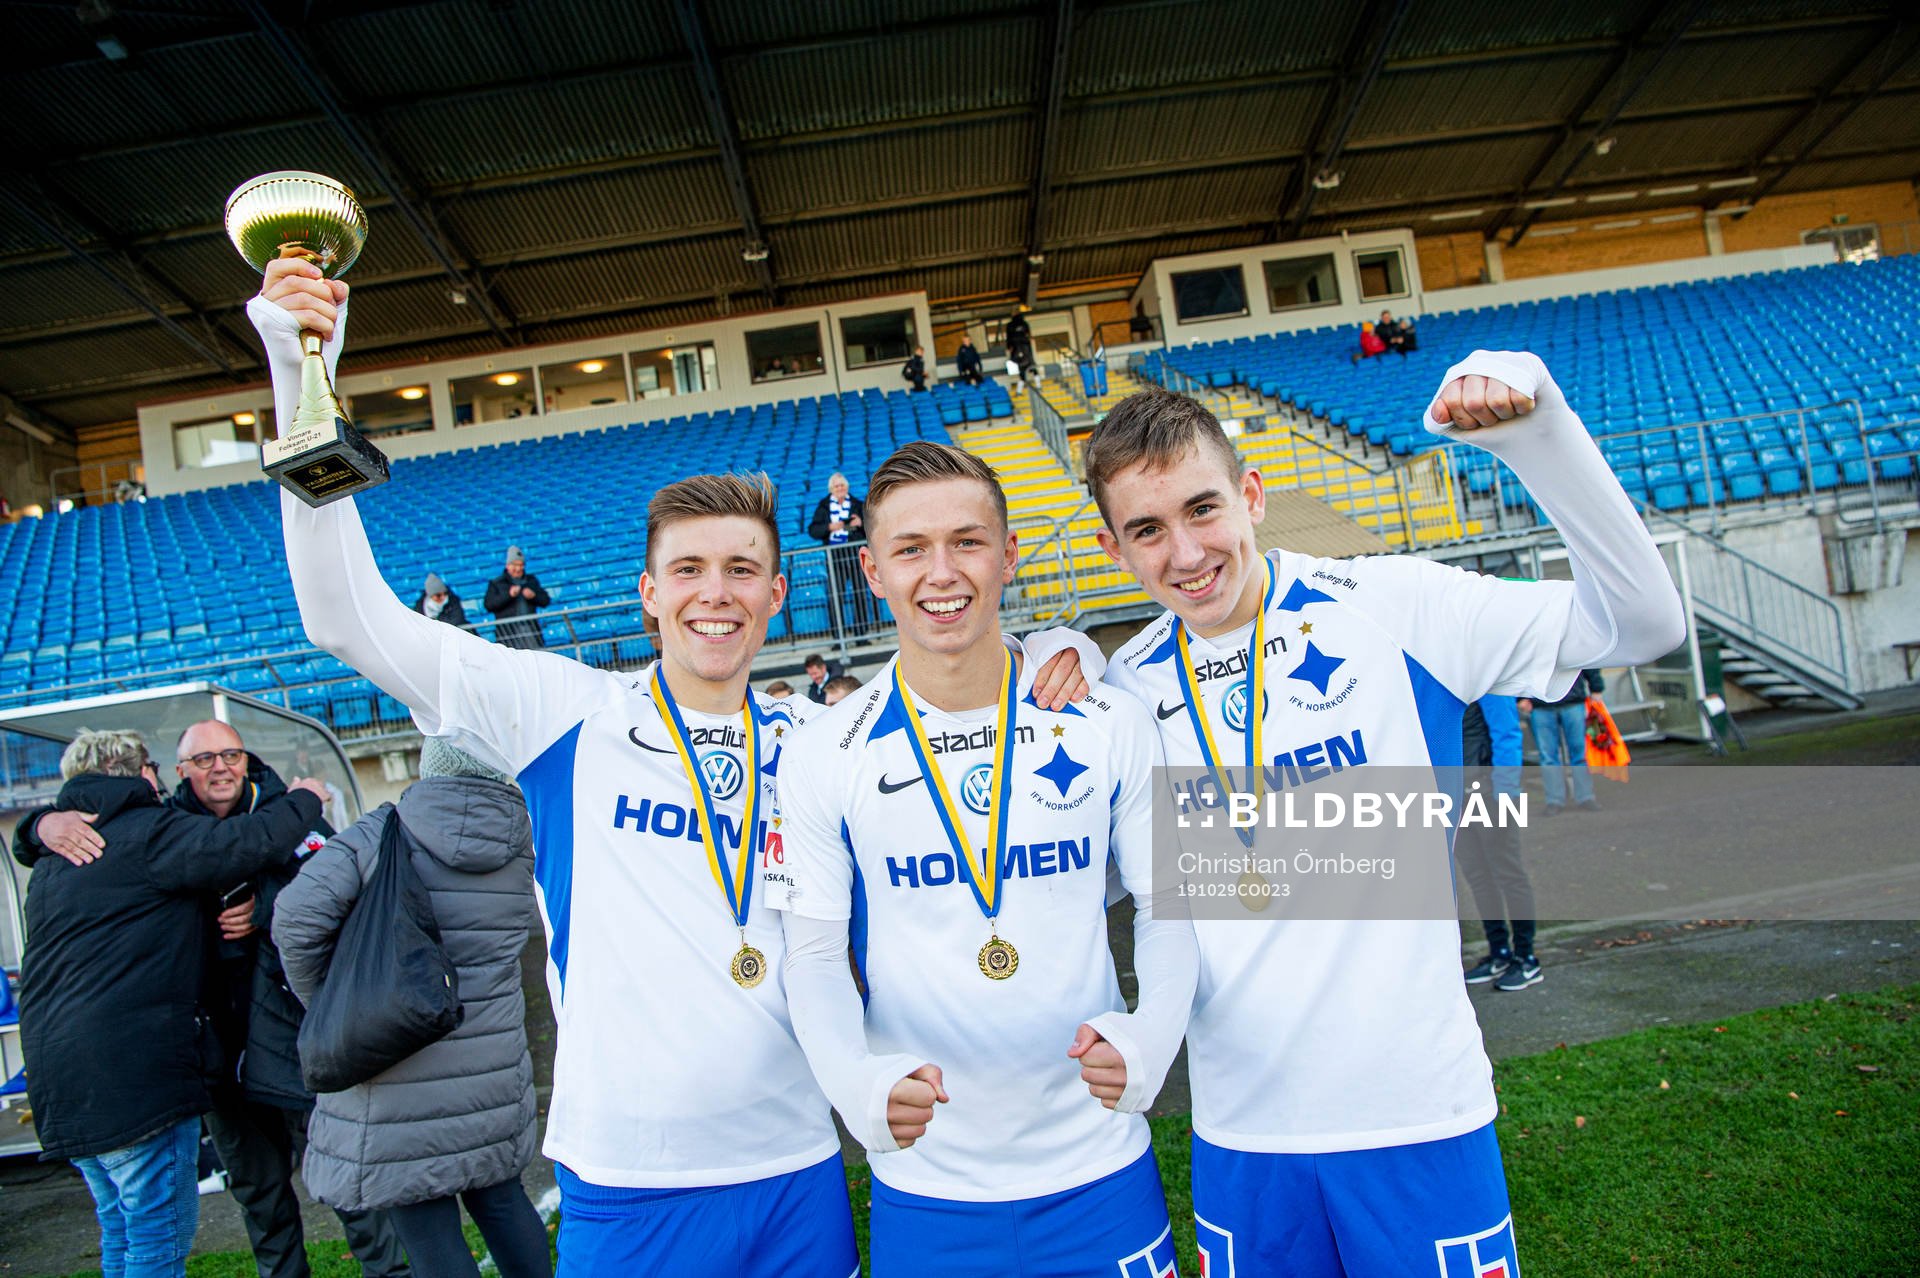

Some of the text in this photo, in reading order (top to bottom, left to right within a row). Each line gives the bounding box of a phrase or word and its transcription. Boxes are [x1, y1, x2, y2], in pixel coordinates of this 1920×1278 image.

[1343, 577, 1358, 590] Bil
[1195, 636, 1287, 683] stadim
[1097, 701, 1111, 712] Bil
[1289, 695, 1304, 708] IFK
[1306, 677, 1358, 712] NORRKÖPING
[840, 689, 881, 750] Söderbergs Bil
[928, 725, 1035, 755] stadim
[1030, 786, 1095, 811] IFK NORRKÖPING
